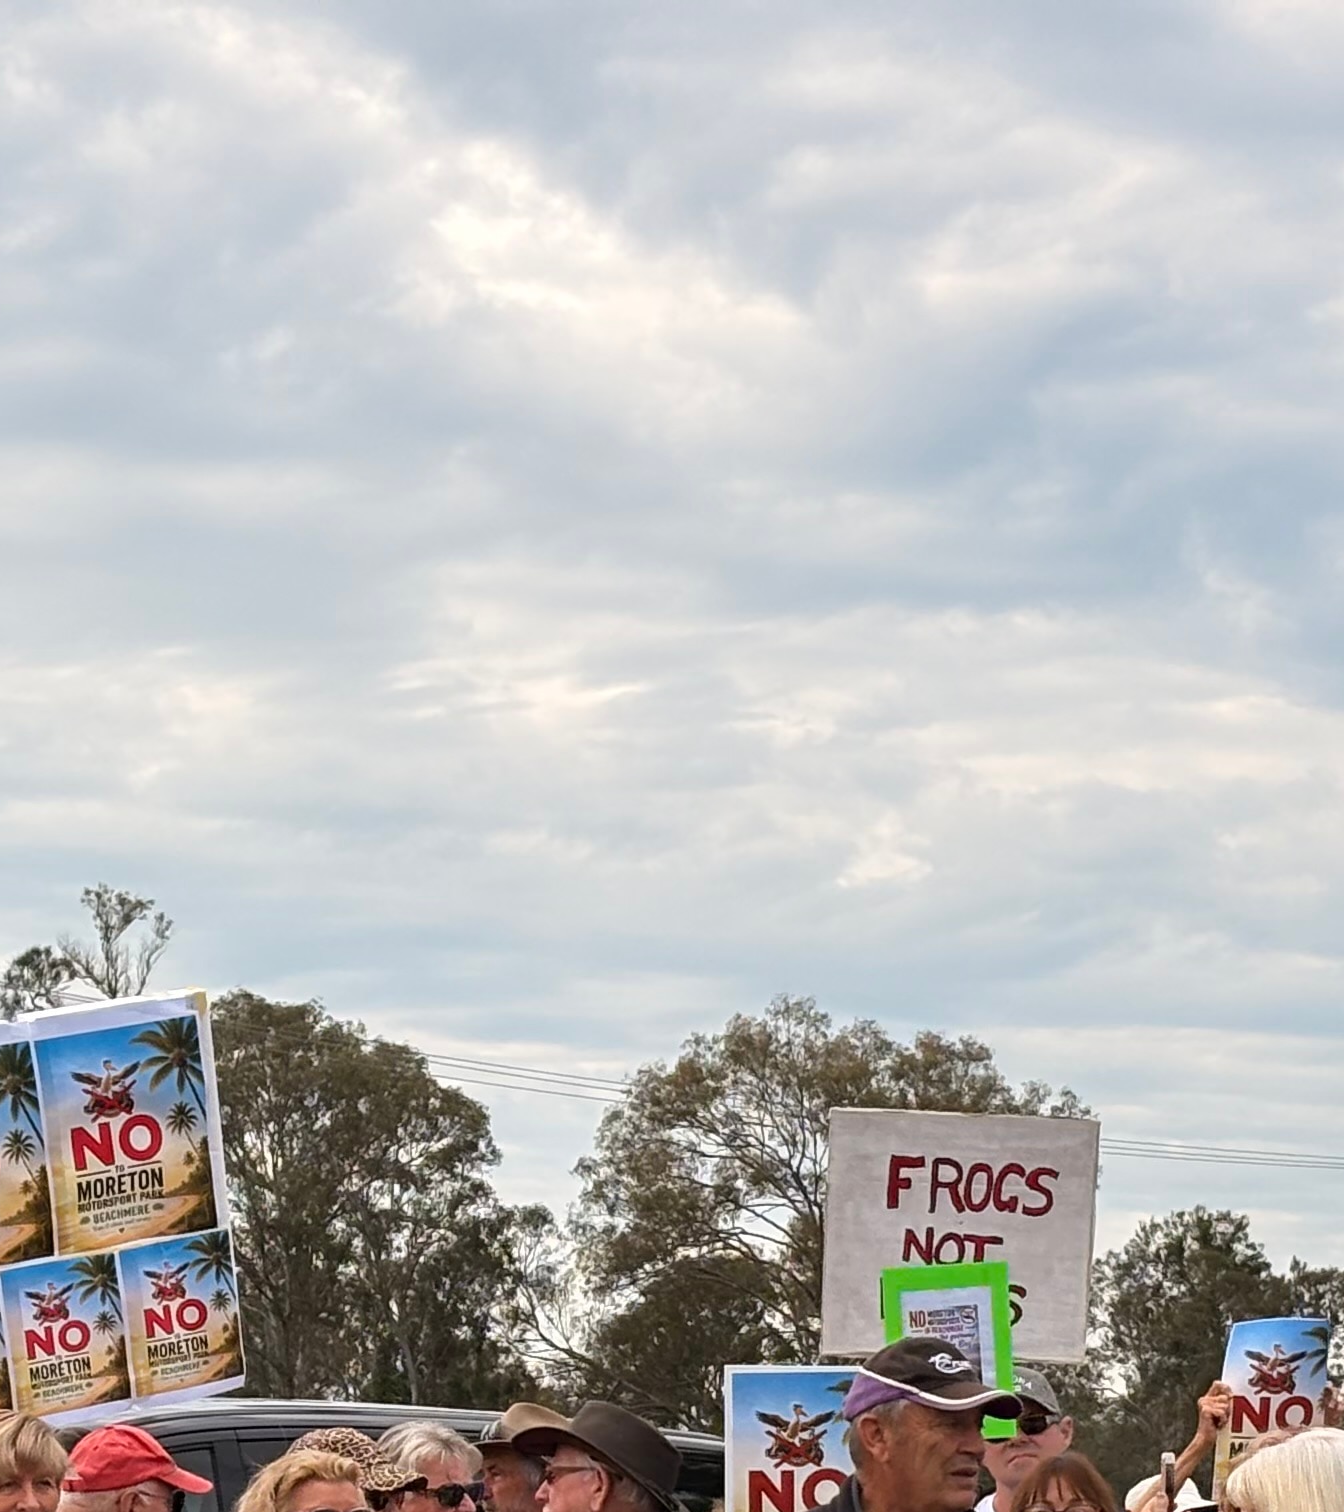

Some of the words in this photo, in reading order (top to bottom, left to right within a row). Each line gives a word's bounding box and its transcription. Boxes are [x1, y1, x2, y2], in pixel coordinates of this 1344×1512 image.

[70, 1114, 163, 1172] NO
[77, 1167, 164, 1203] MORETON
[78, 1194, 137, 1213] MOTORSPORT
[886, 1155, 1060, 1217] FROGS
[93, 1204, 150, 1224] BEACHMERE
[902, 1228, 1003, 1266] NOT
[144, 1299, 208, 1339] NO
[909, 1310, 926, 1328] NO
[24, 1320, 91, 1360] NO
[147, 1335, 209, 1360] MORETON
[29, 1356, 92, 1382] MORETON
[1232, 1395, 1313, 1434] NO
